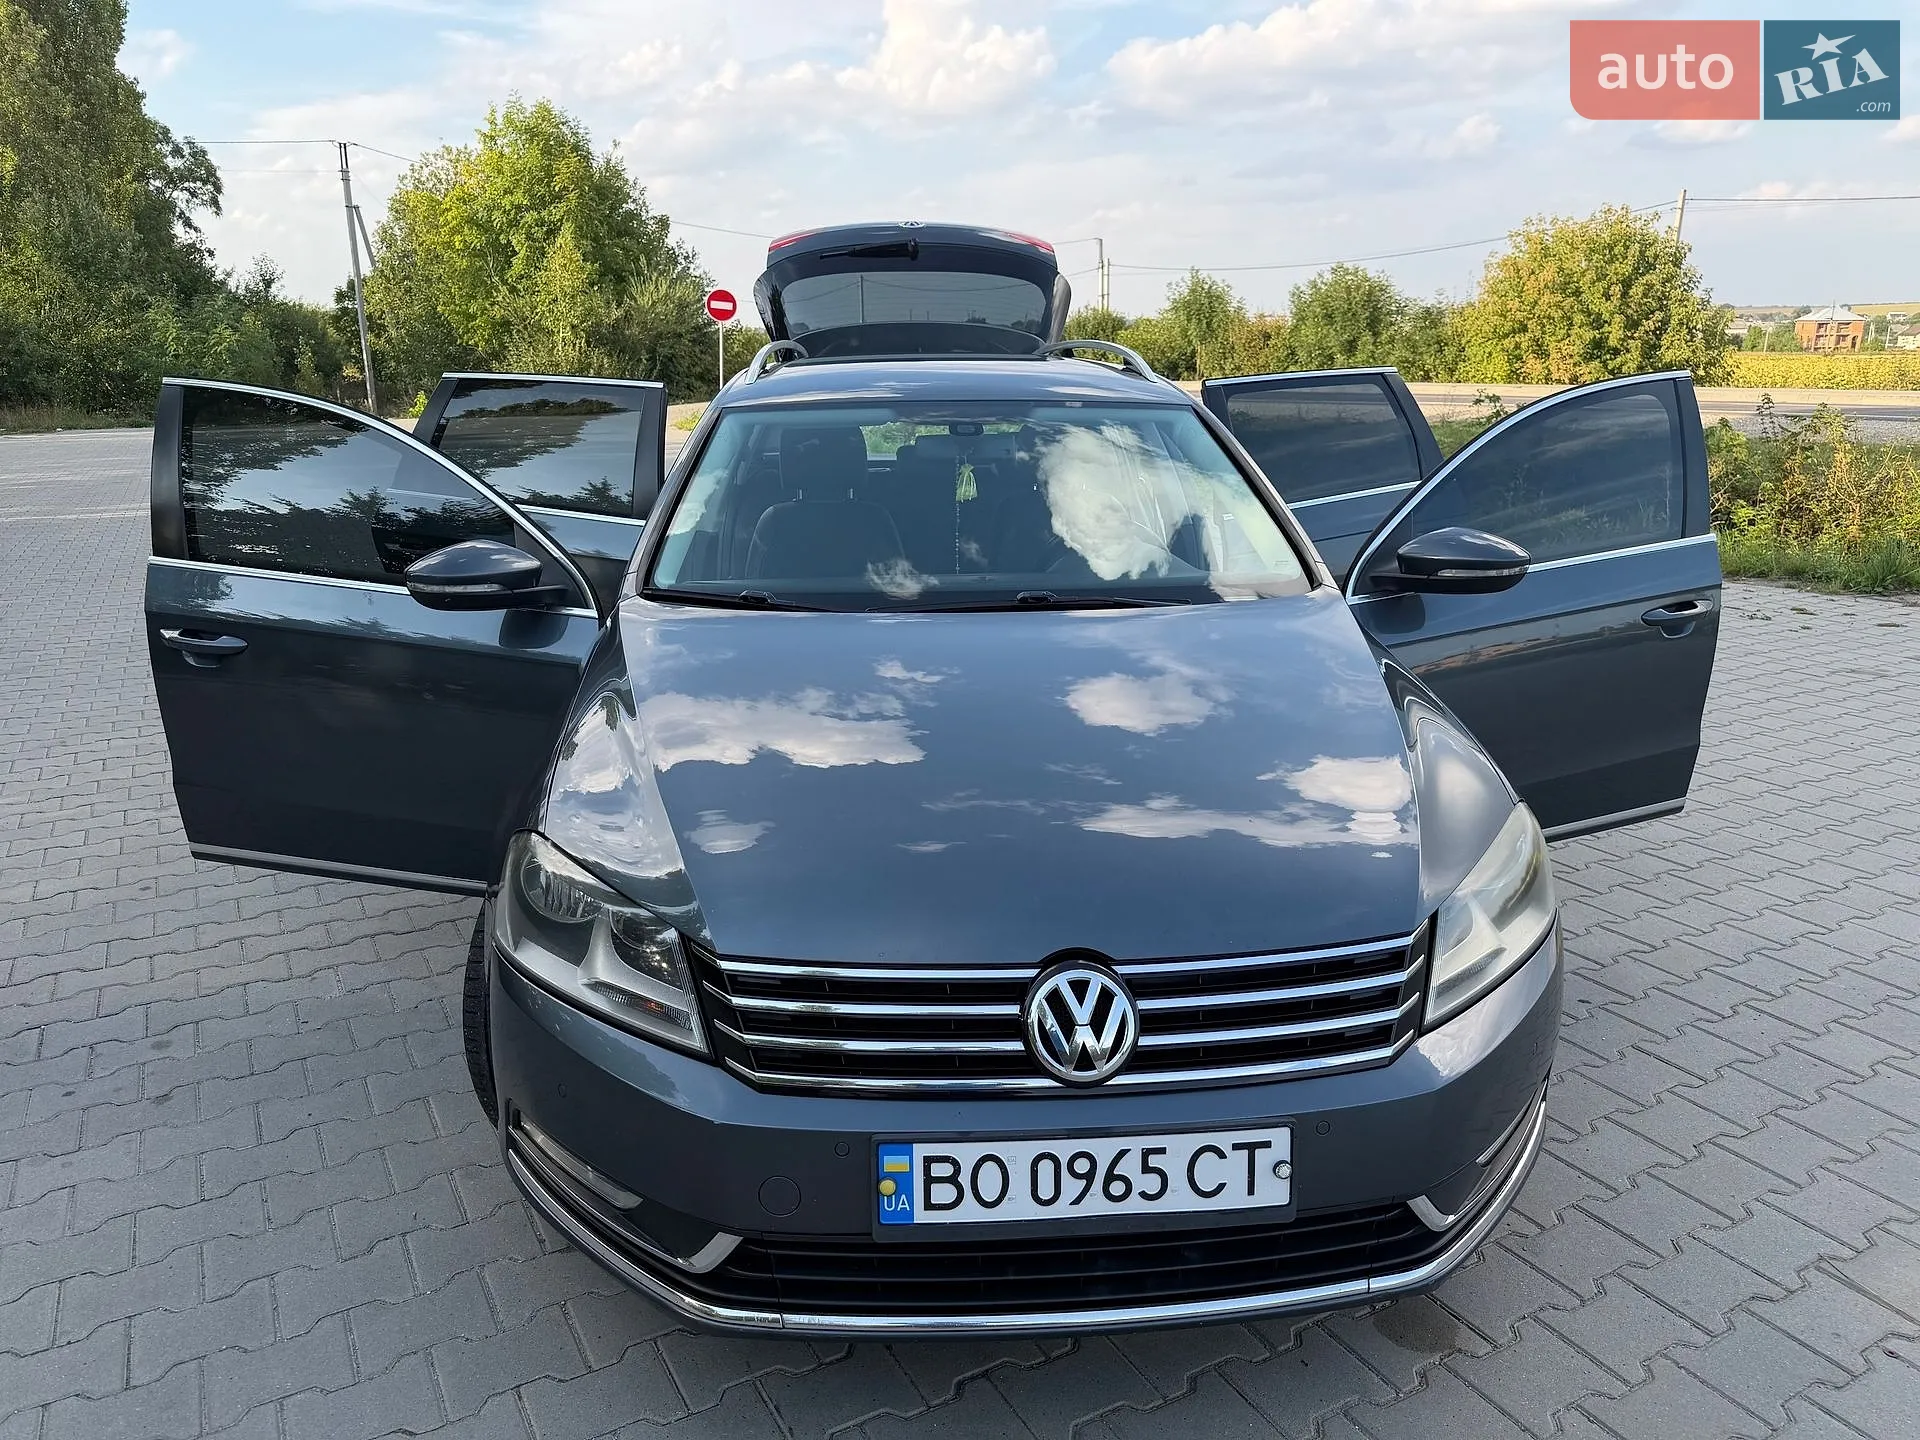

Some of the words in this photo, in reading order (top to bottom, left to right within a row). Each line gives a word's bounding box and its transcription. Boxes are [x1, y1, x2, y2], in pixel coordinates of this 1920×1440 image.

[922, 1153, 1010, 1211] BO
[1030, 1146, 1169, 1207] 0965
[1187, 1139, 1273, 1199] CT
[883, 1194, 911, 1212] UA
